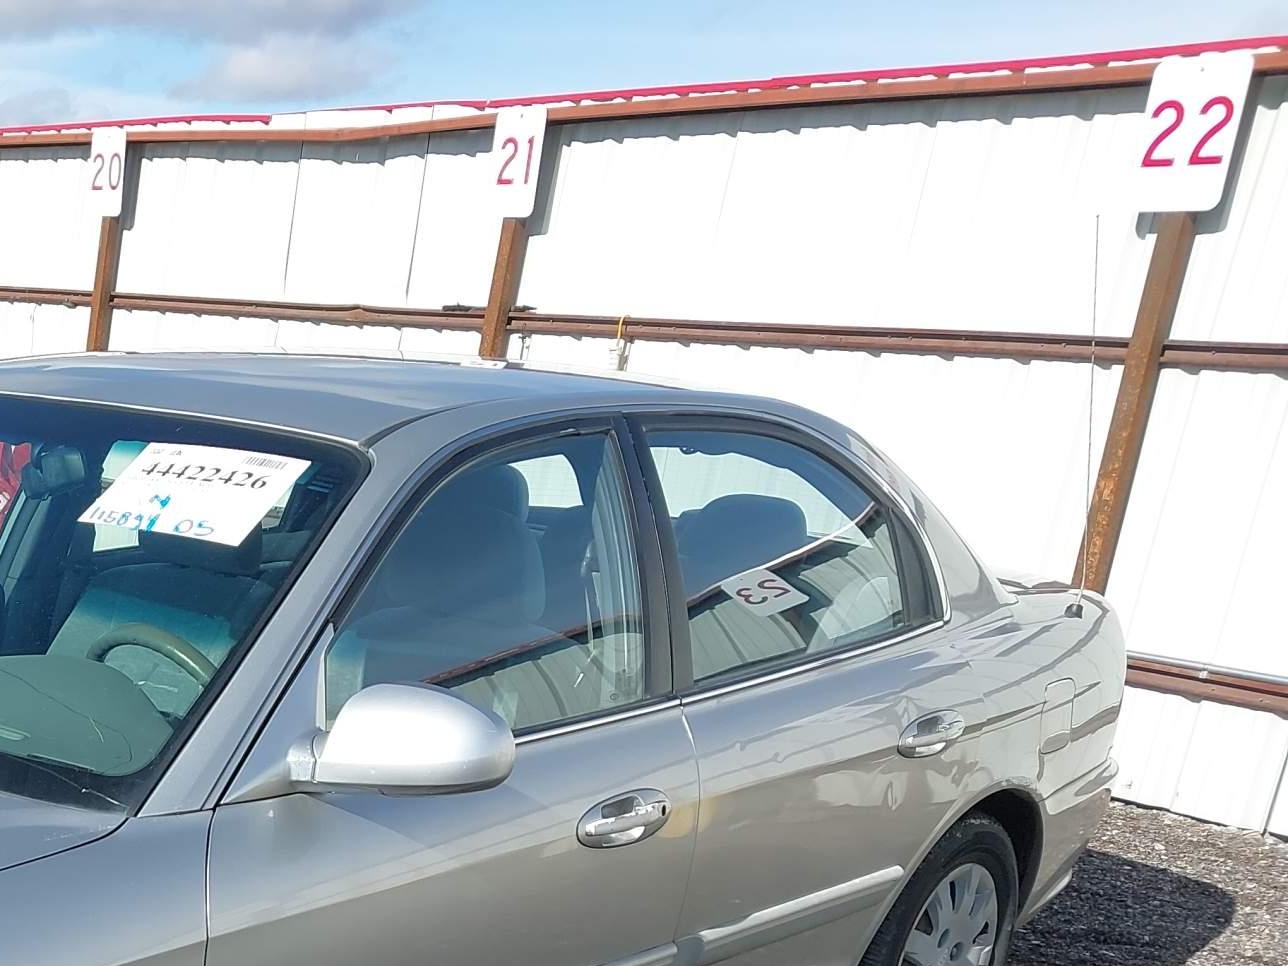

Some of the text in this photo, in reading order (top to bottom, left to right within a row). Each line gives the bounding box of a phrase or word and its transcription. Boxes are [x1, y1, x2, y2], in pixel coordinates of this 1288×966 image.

[1141, 95, 1234, 167] 22
[91, 152, 122, 190] 20
[496, 135, 535, 185] 21
[141, 462, 272, 490] 44422426
